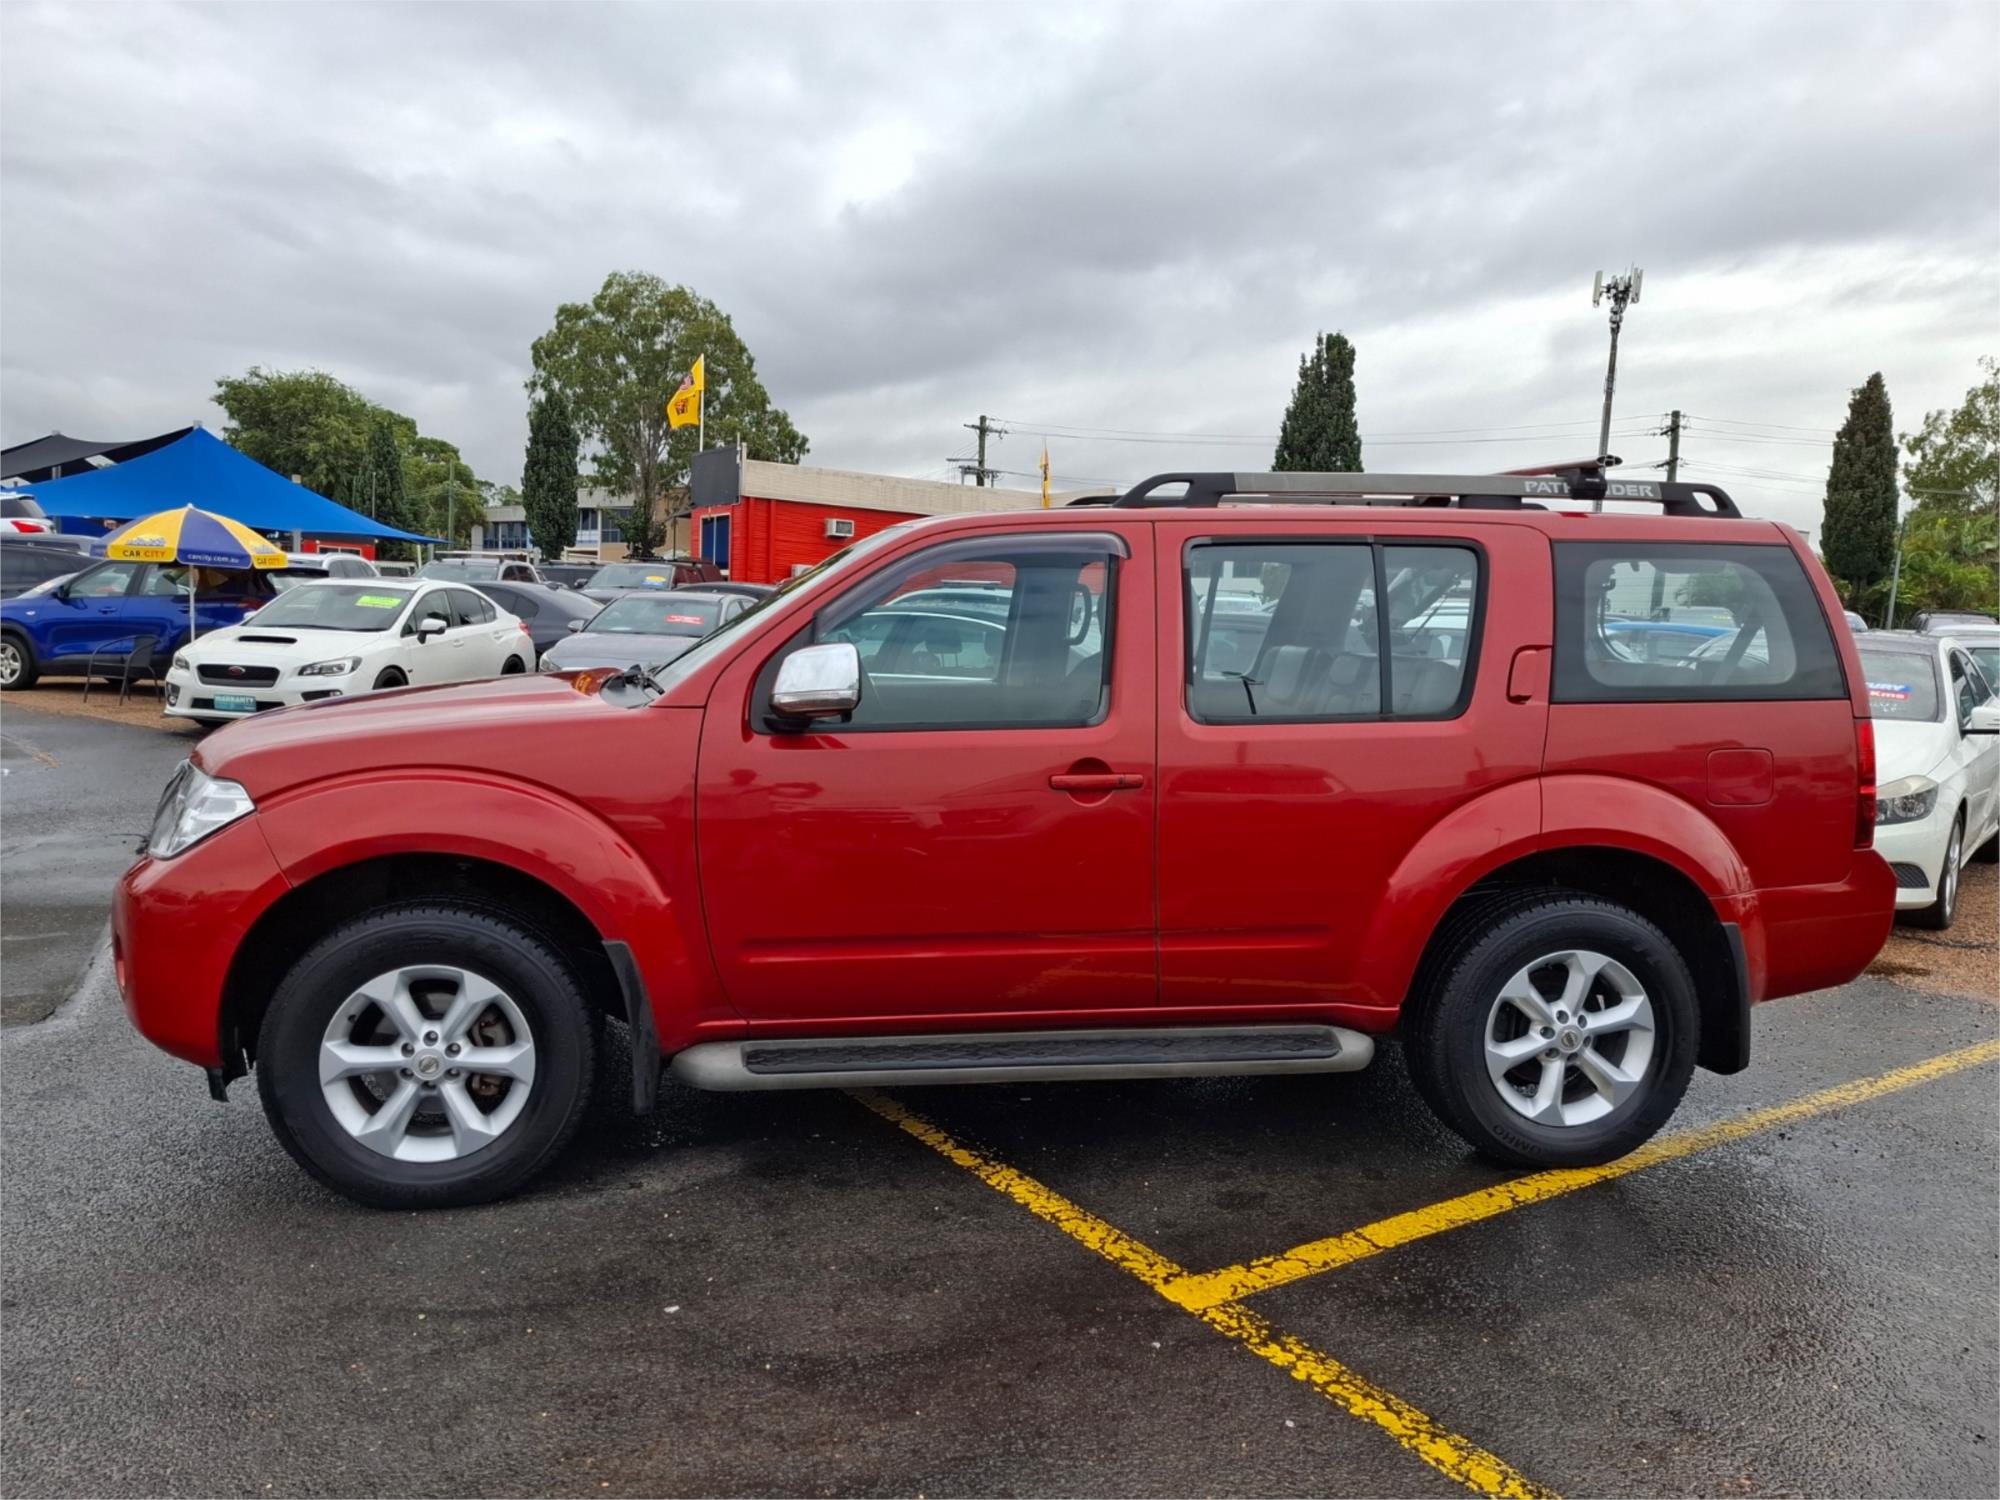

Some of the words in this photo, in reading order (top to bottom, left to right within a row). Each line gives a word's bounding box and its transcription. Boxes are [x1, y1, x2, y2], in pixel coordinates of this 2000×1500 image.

[122, 549, 140, 557] CAR
[144, 550, 166, 558] CITY
[187, 552, 240, 564] carcity.com.au
